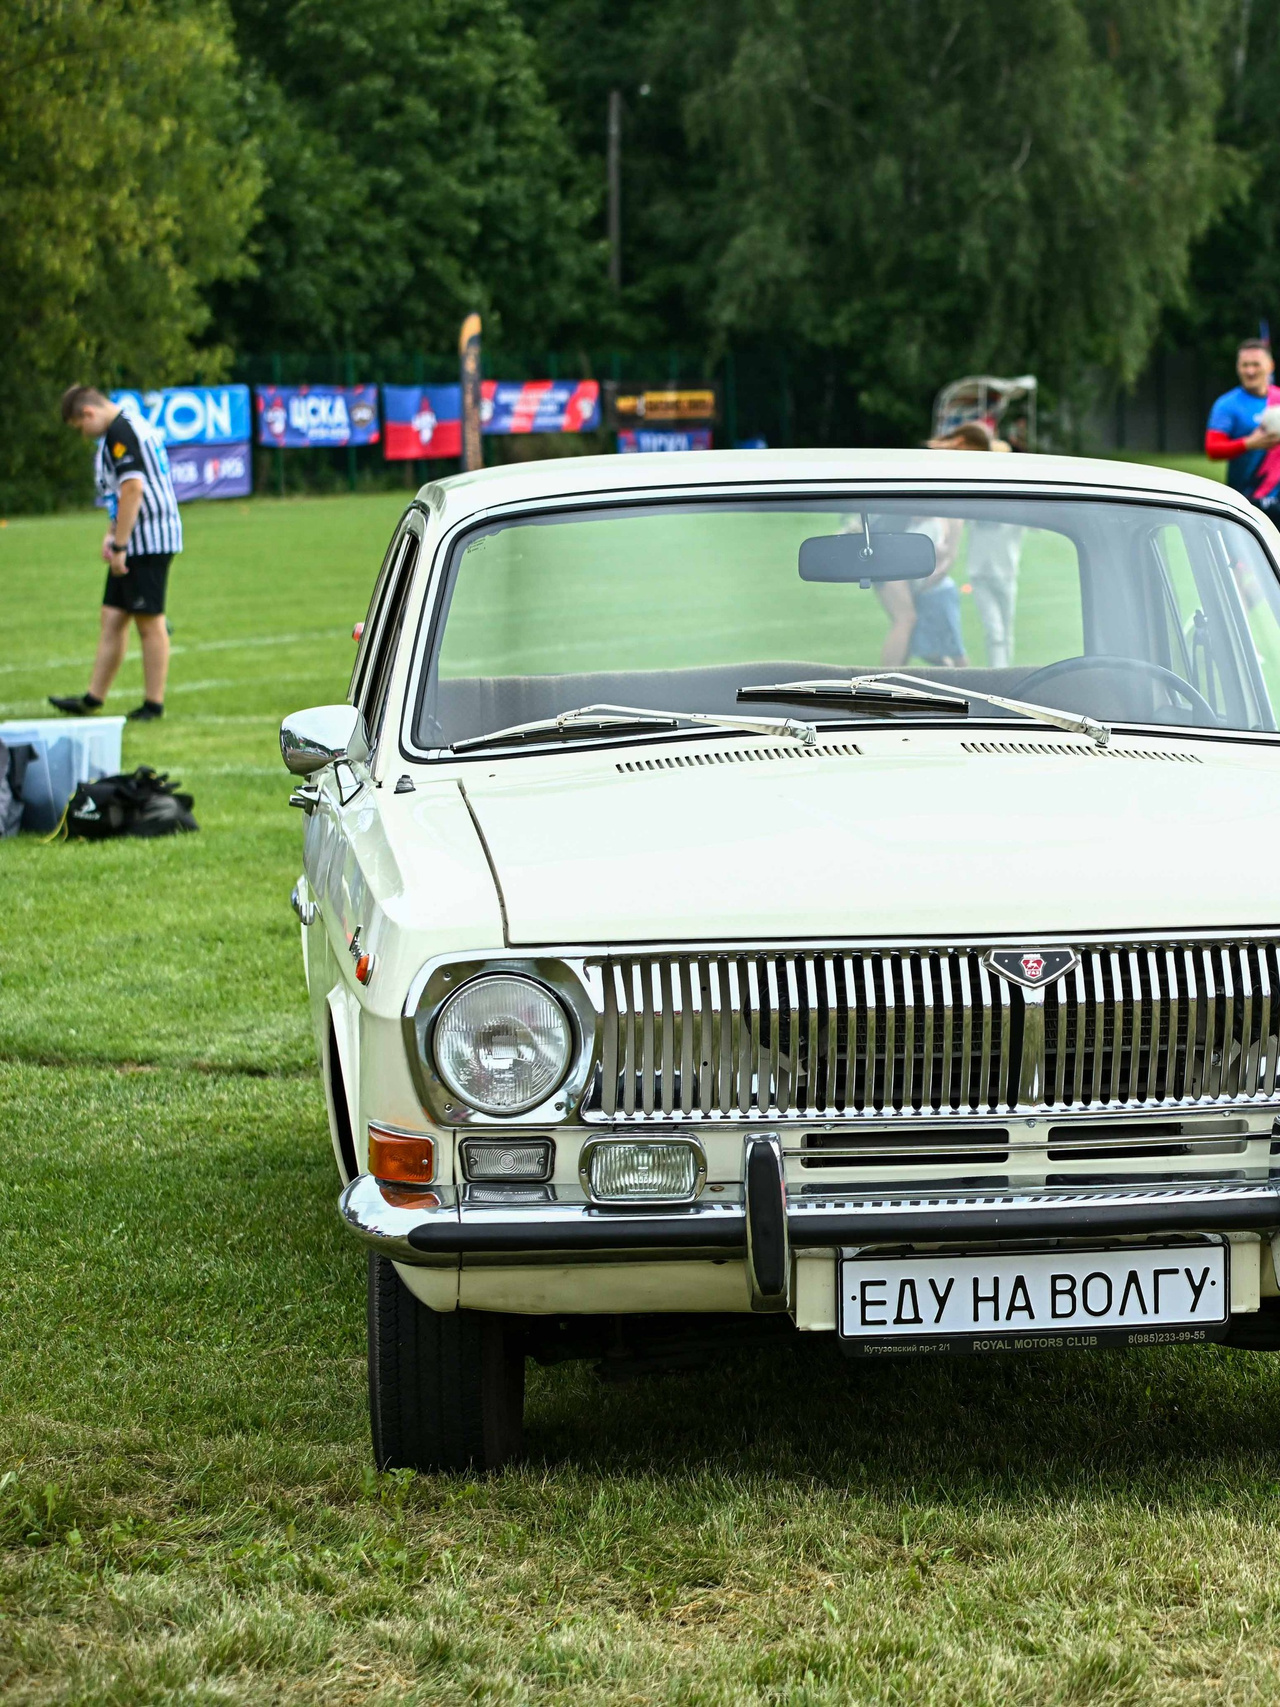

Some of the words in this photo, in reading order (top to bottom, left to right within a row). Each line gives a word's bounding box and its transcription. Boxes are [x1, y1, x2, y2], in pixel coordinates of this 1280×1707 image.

[288, 395, 348, 433] ЦСКА
[860, 1277, 955, 1326] ЕДУ
[972, 1275, 1035, 1322] НА
[1050, 1267, 1210, 1319] ВОЛГУ
[973, 1340, 1012, 1350] ROYAL
[1014, 1338, 1064, 1349] MOTORS
[1066, 1336, 1098, 1347] CLUB
[1128, 1330, 1206, 1344] 8(985)233-99-55
[864, 1344, 917, 1354] Кутузовский
[919, 1345, 937, 1353] пр-т
[938, 1343, 951, 1351] 2/1
